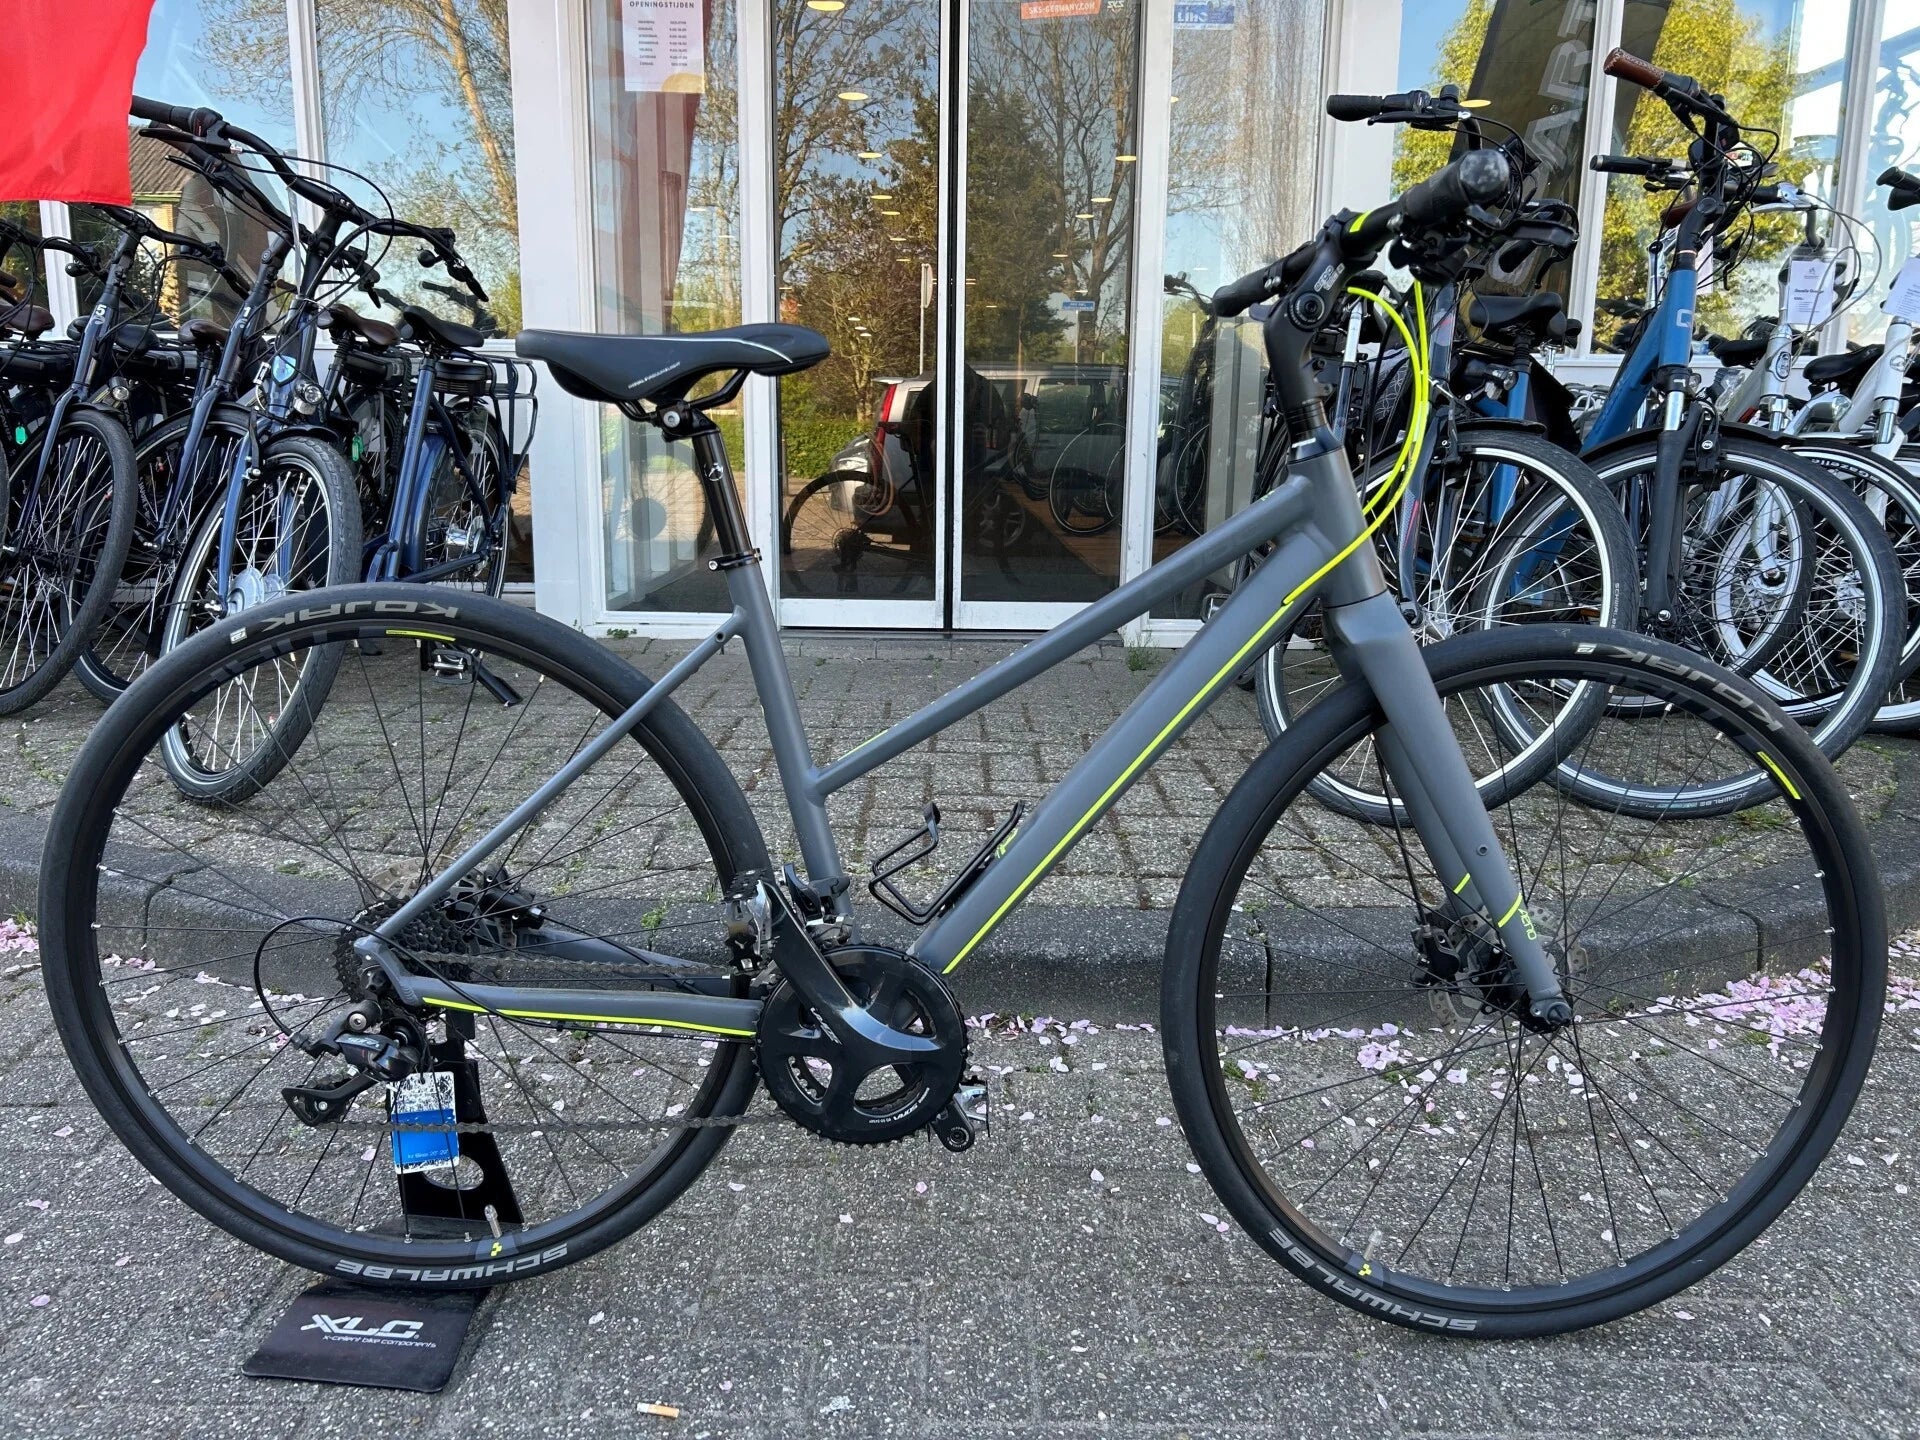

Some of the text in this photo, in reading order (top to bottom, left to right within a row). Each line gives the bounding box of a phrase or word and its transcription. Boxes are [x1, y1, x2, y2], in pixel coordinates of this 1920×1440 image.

[629, 1, 695, 9] OPENINGSTIJDEN
[1029, 2, 1095, 15] SKS-GERMANY.COM
[96, 304, 107, 316] 5
[243, 306, 252, 318] 1
[260, 600, 459, 633] KOJAK
[1611, 646, 1784, 732] KOJAK
[1518, 907, 1538, 941] AERO
[336, 1244, 570, 1282] SCHWALBE
[1267, 1229, 1478, 1333] SCHWALBE
[300, 1314, 424, 1339] XLC
[362, 1337, 381, 1345] bike
[381, 1339, 437, 1349] components
